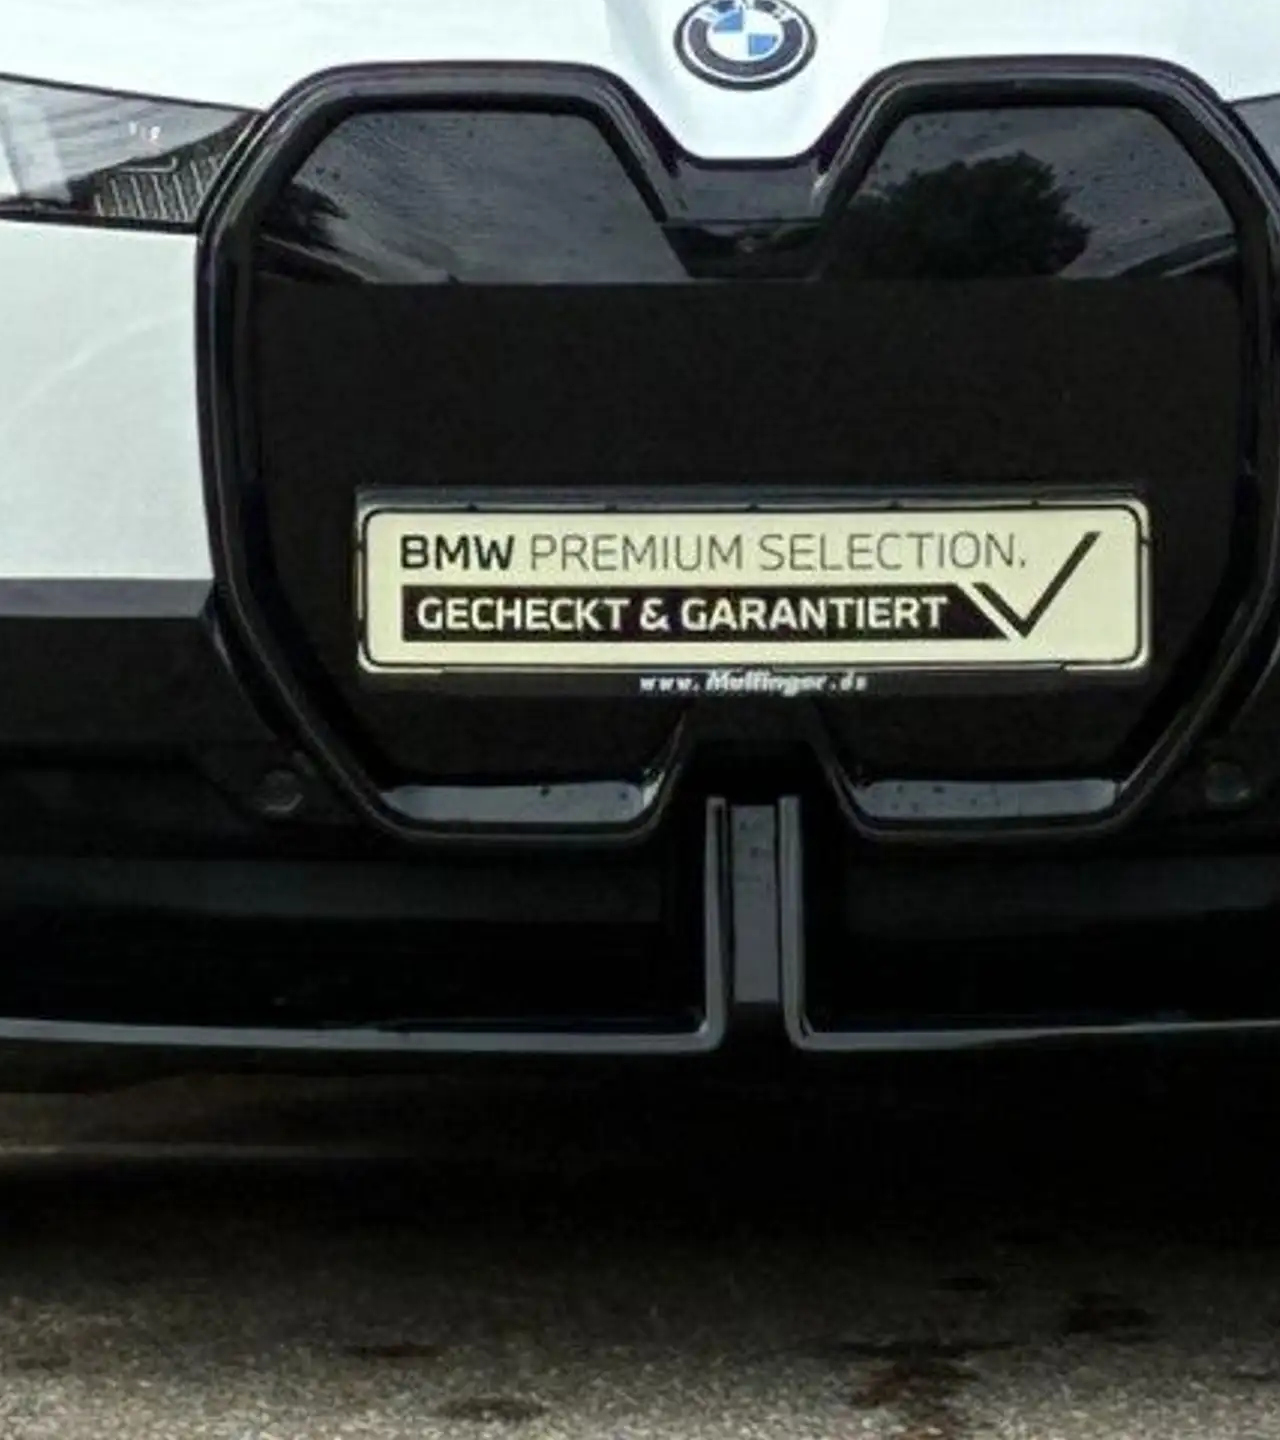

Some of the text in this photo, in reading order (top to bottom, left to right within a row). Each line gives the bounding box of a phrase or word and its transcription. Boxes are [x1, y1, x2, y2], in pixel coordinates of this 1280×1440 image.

[400, 531, 1027, 572] BMW PREMIUM SELECTION.
[417, 595, 949, 631] GECHECKT & GARANTIERT
